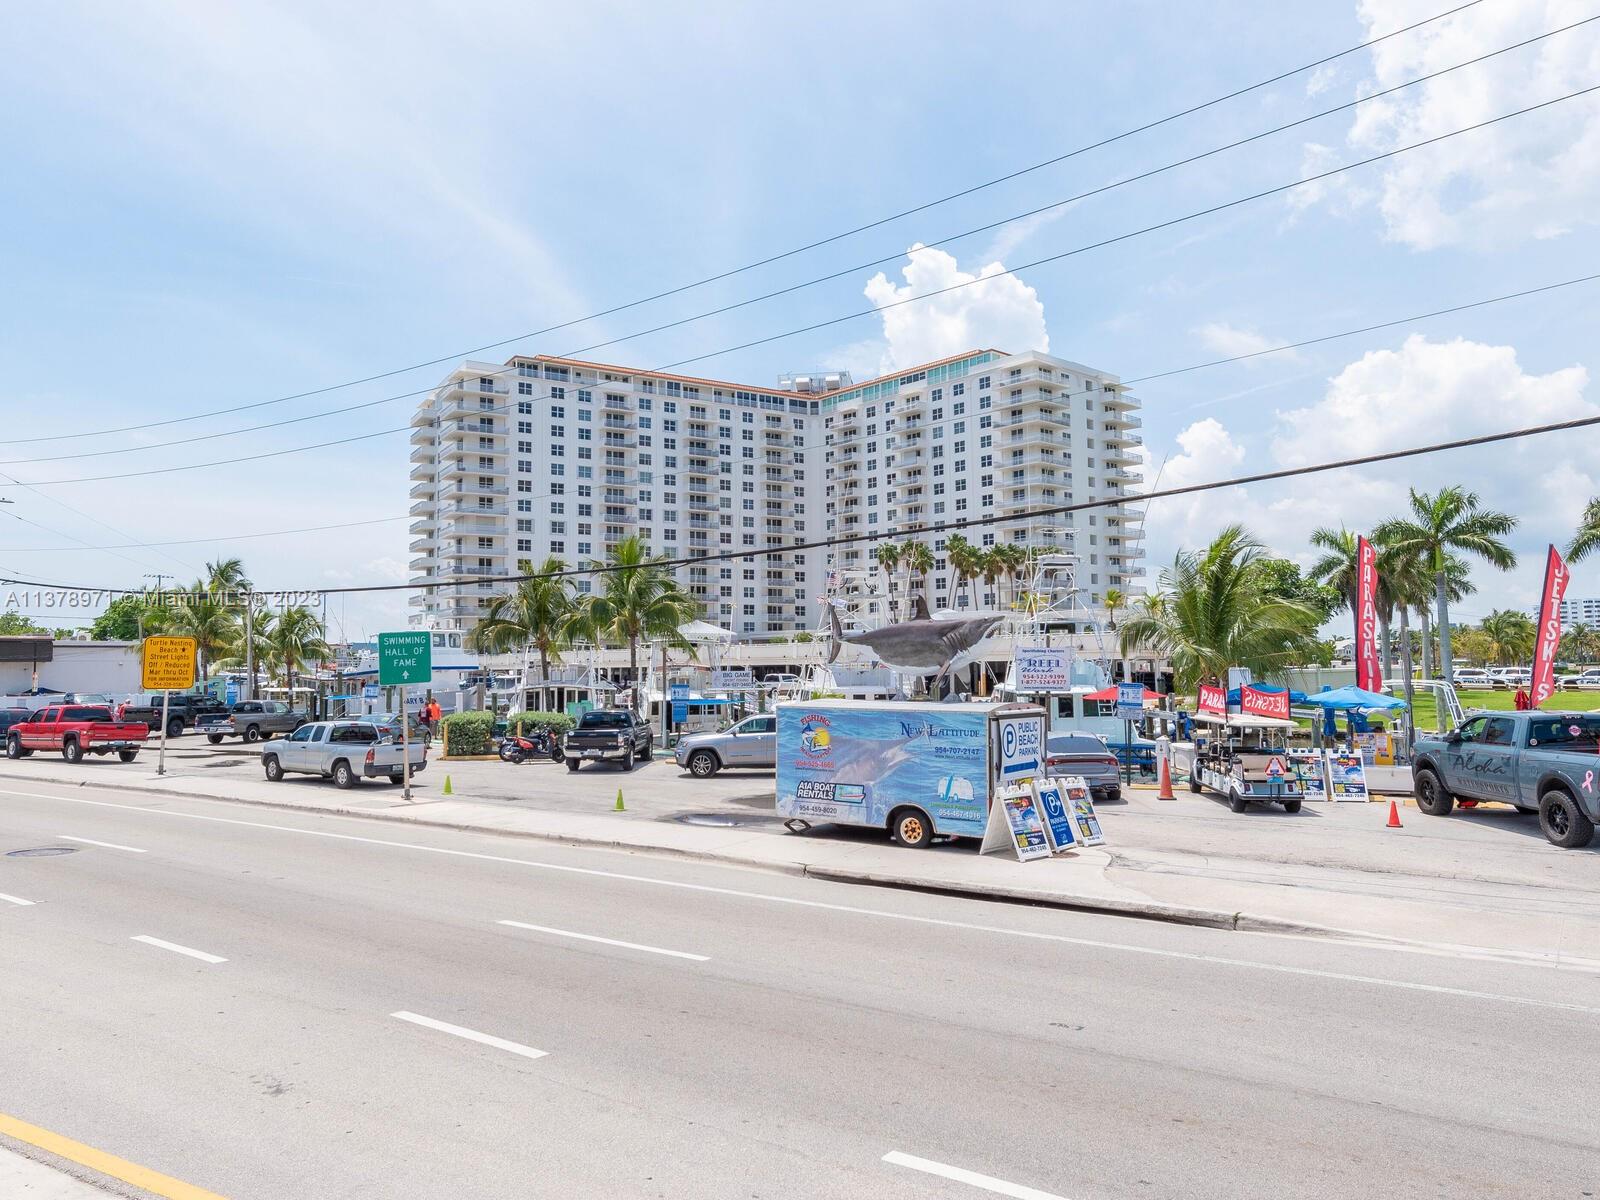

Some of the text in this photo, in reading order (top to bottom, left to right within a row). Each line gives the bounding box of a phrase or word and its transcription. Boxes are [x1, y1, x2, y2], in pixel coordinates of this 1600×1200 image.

[1537, 561, 1565, 701] JETSKIS
[170, 640, 192, 648] Nesting
[384, 636, 426, 646] SWIMMING
[385, 646, 425, 656] HALL OF
[393, 658, 417, 667] FAME
[1027, 658, 1063, 668] REEL
[800, 713, 832, 727] FISHING
[1018, 721, 1039, 733] PUBLIC
[1018, 734, 1039, 746] BEACH
[1018, 746, 1039, 756] PARKING
[1453, 752, 1506, 775] Aloha
[798, 781, 812, 790] A1A
[813, 782, 835, 791] BOAT
[797, 789, 834, 800] RENTALS
[1050, 815, 1067, 825] PARKING
